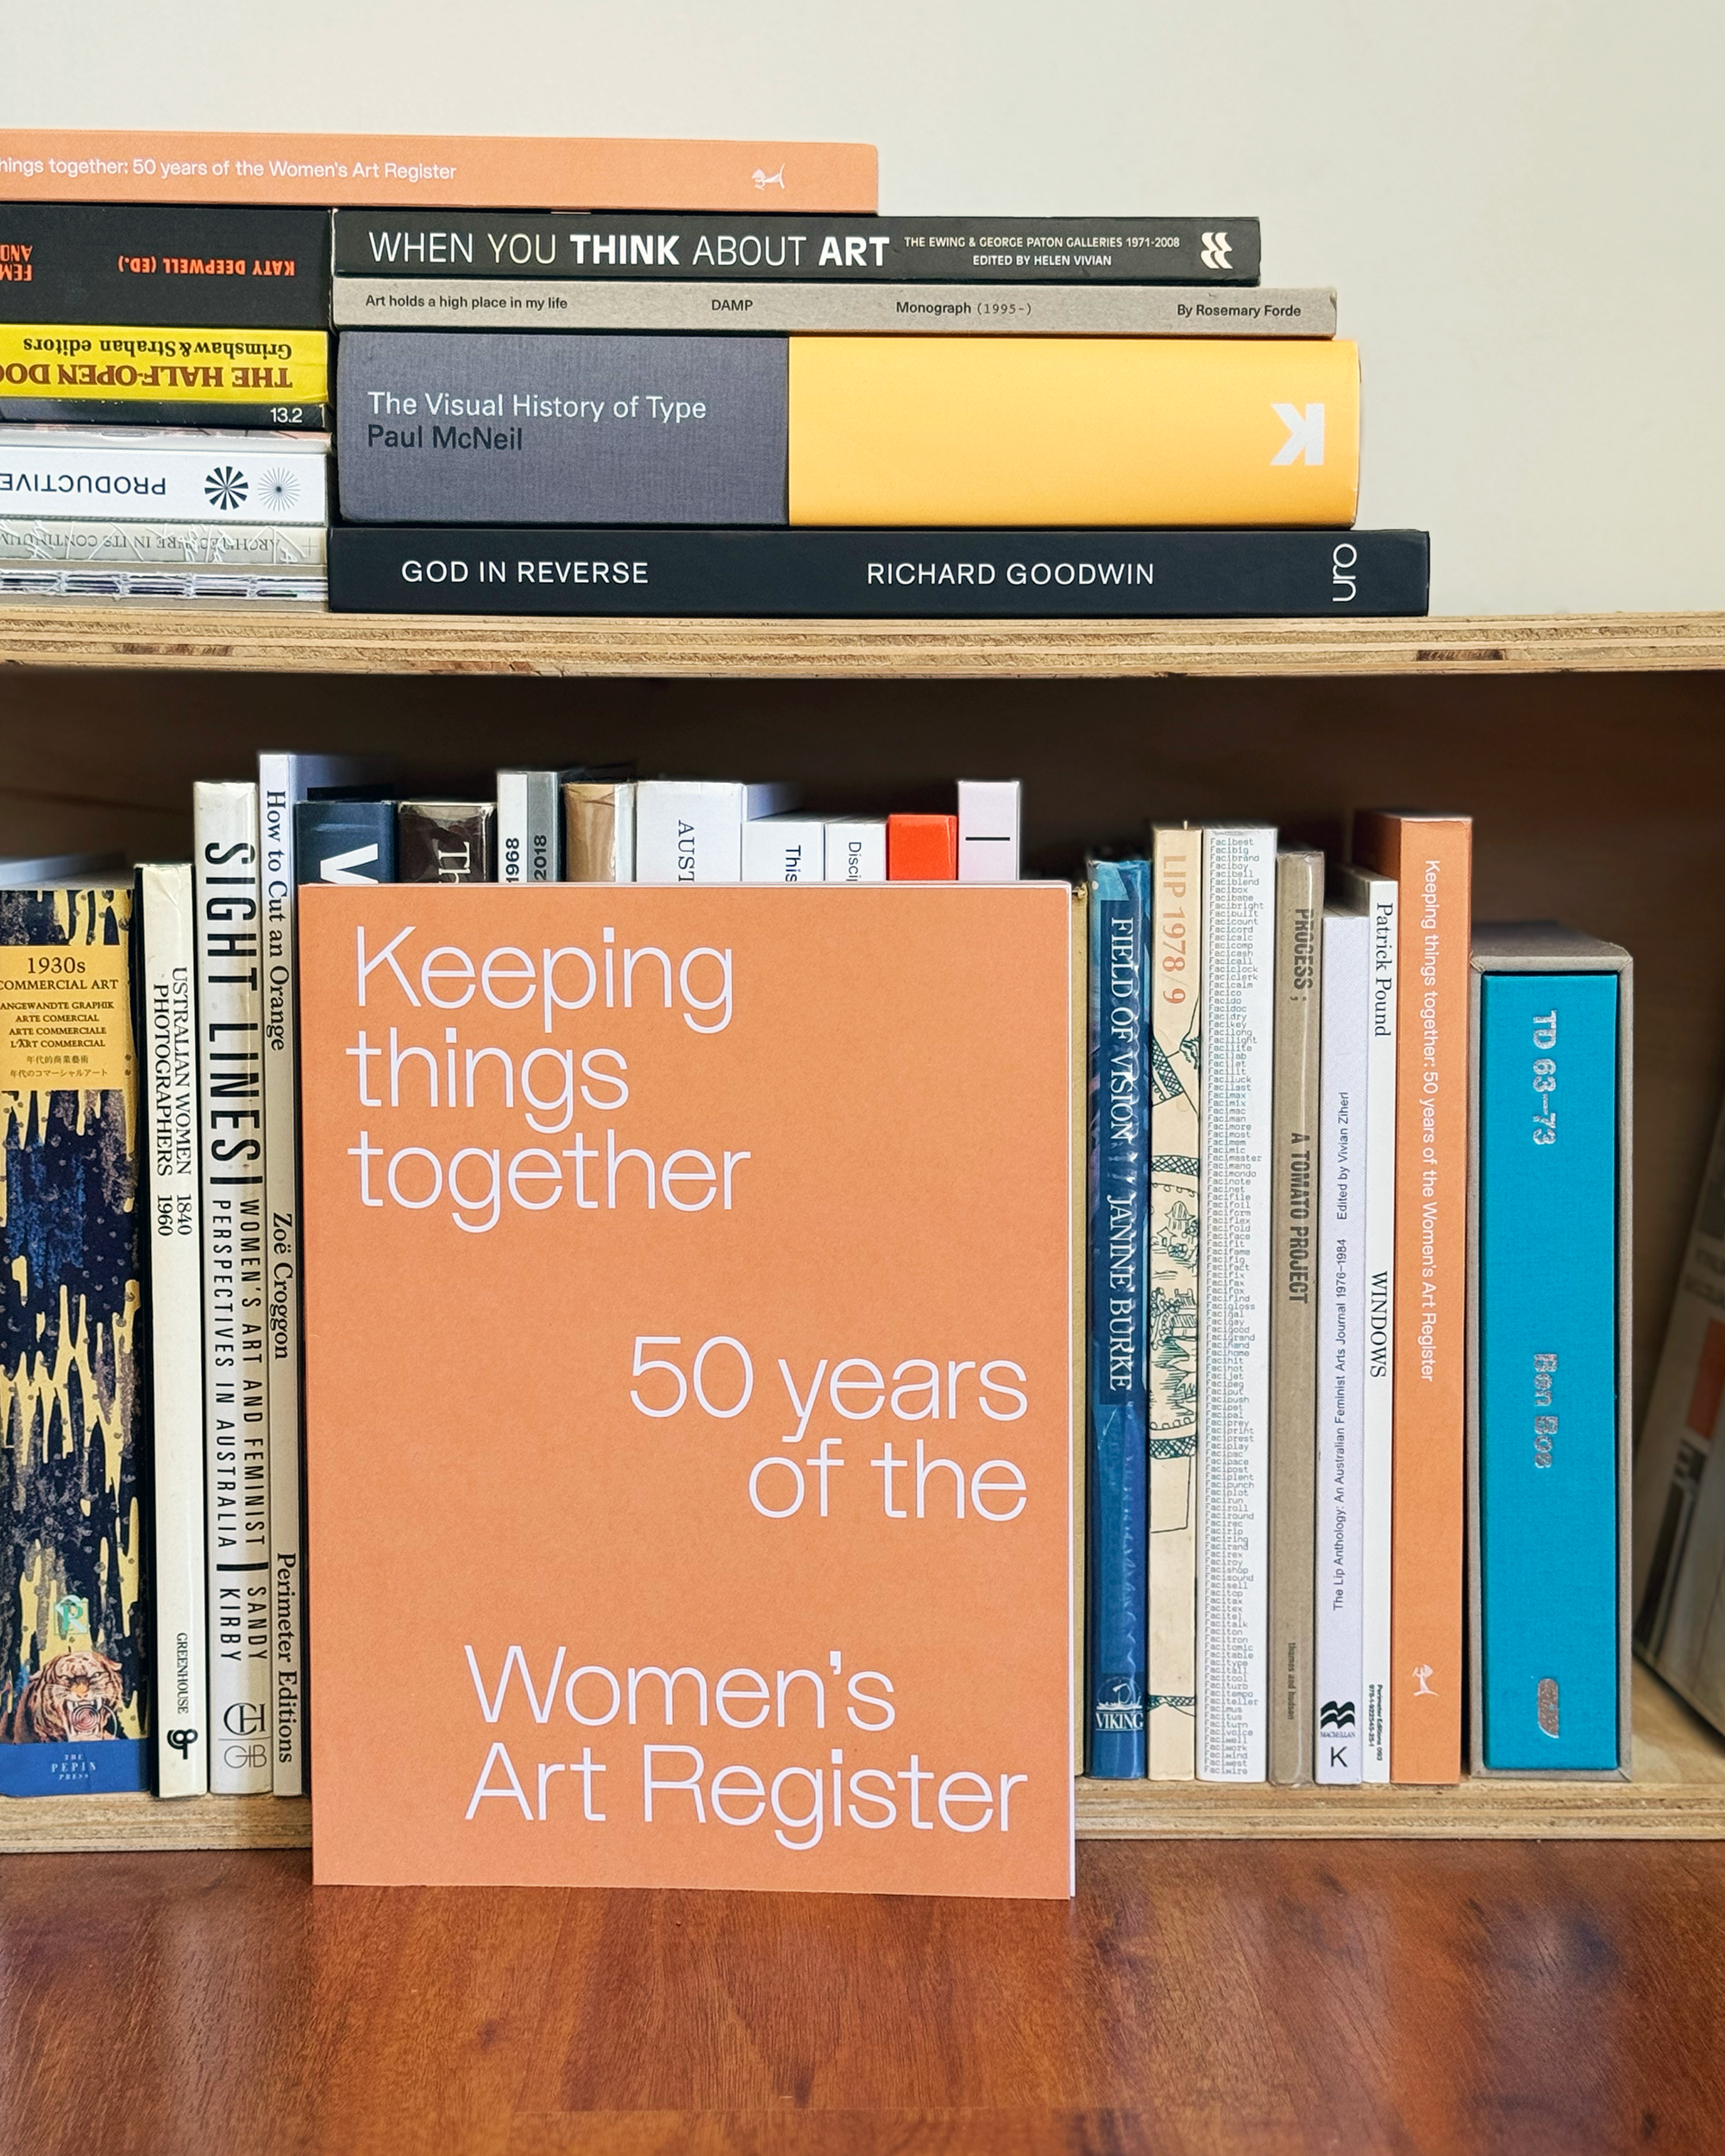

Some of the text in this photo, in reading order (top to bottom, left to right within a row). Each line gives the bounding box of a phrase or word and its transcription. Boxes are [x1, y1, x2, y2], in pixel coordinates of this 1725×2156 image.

[48, 158, 129, 179] together:
[133, 159, 155, 176] 50
[160, 162, 209, 179] years
[211, 160, 230, 177] of
[235, 160, 264, 178] the
[268, 161, 348, 179] Women's
[351, 162, 380, 179] Art
[385, 163, 457, 183] Register
[368, 232, 890, 267] WHEN YOU THINK ABOUT ART
[905, 237, 1181, 248] THE EWING & GEORGE PATON GALLERIES 1971-2008
[973, 255, 1112, 266] EDITED BY HELEN VIVIAN
[117, 255, 295, 277] KATY DEEPWELL (ED.)
[366, 295, 568, 313] Art holds a high place in my life
[712, 299, 753, 312] DAMP
[896, 302, 972, 318] Monograph
[1177, 304, 1302, 320] By Rosemary Forde
[23, 339, 91, 356] editors
[58, 364, 292, 388] THE HALF-OPEN
[270, 407, 303, 423] 13.2
[367, 392, 706, 423] The Visual History of Type
[368, 424, 523, 450] Paul McNeil
[0, 473, 166, 495] PRODUCTIVE
[104, 536, 128, 548] ITS
[134, 536, 151, 548] IN
[402, 561, 649, 584] GOD IN REVERSE
[867, 563, 1154, 586] RICHARD GOODWIN
[1332, 542, 1358, 602] uro
[505, 837, 520, 882] 1968
[534, 835, 548, 881] 2018
[1210, 846, 1249, 856] Facibig
[1210, 862, 1249, 871] Faciboy
[1163, 855, 1187, 898] LIP
[267, 791, 289, 1051] How to Cut an Orange
[28, 956, 86, 975] 1930s
[91, 979, 119, 990] ART
[356, 925, 734, 1035] Keeping
[1375, 902, 1394, 1037] Patrick Pound
[15, 1014, 99, 1023] ARTE COMERCIAL
[71, 1001, 115, 1010] GRAPHIK
[204, 843, 261, 1163] SIGHT LINES
[9, 1026, 107, 1036] ARTE COMMERCIALE
[41, 1039, 105, 1048] COMMERCIAL
[1110, 917, 1133, 1141] FIELD OF VISION
[1533, 1010, 1558, 1050] TD
[153, 983, 173, 1176] PHOTOGRAPHERS
[172, 966, 192, 1175] USTRALIAN WOMEN
[345, 1026, 630, 1134] things
[1289, 908, 1314, 1304] PROCESS A TOMATO PROJECT
[1417, 860, 1440, 1382] Keeping together: Women's Register
[1337, 1092, 1350, 1219] Edited by Vivian Ziherl
[347, 1128, 752, 1233] together
[156, 1194, 173, 1237] 1960
[176, 1194, 193, 1236] 1840
[270, 1213, 294, 1360] Zoë Croggon
[1107, 1194, 1133, 1392] JANINE BURKE
[1370, 1270, 1388, 1378] WINDOWS
[212, 1200, 237, 1549] PERSPECTIVES IN AUSTRALIA
[239, 1200, 266, 1545] WOMEN'S ART AND FEMINIST
[630, 1335, 1028, 1443] 50 years
[1333, 1303, 1347, 1611] The Lip Anthology: An Australian Feminist Arts Journal
[749, 1438, 1027, 1522] of the
[219, 1589, 242, 1662] KIRBY
[247, 1587, 268, 1661] SANDY
[176, 1632, 189, 1714] GREENHOUSE
[276, 1552, 298, 1764] Perimeter Editions
[463, 1645, 896, 1732] Women's
[1288, 1674, 1296, 1689] and
[1095, 1712, 1144, 1730] VIKING
[1287, 1691, 1296, 1720] hudson
[1330, 1746, 1349, 1768] K
[465, 1742, 1028, 1851] Art Register
